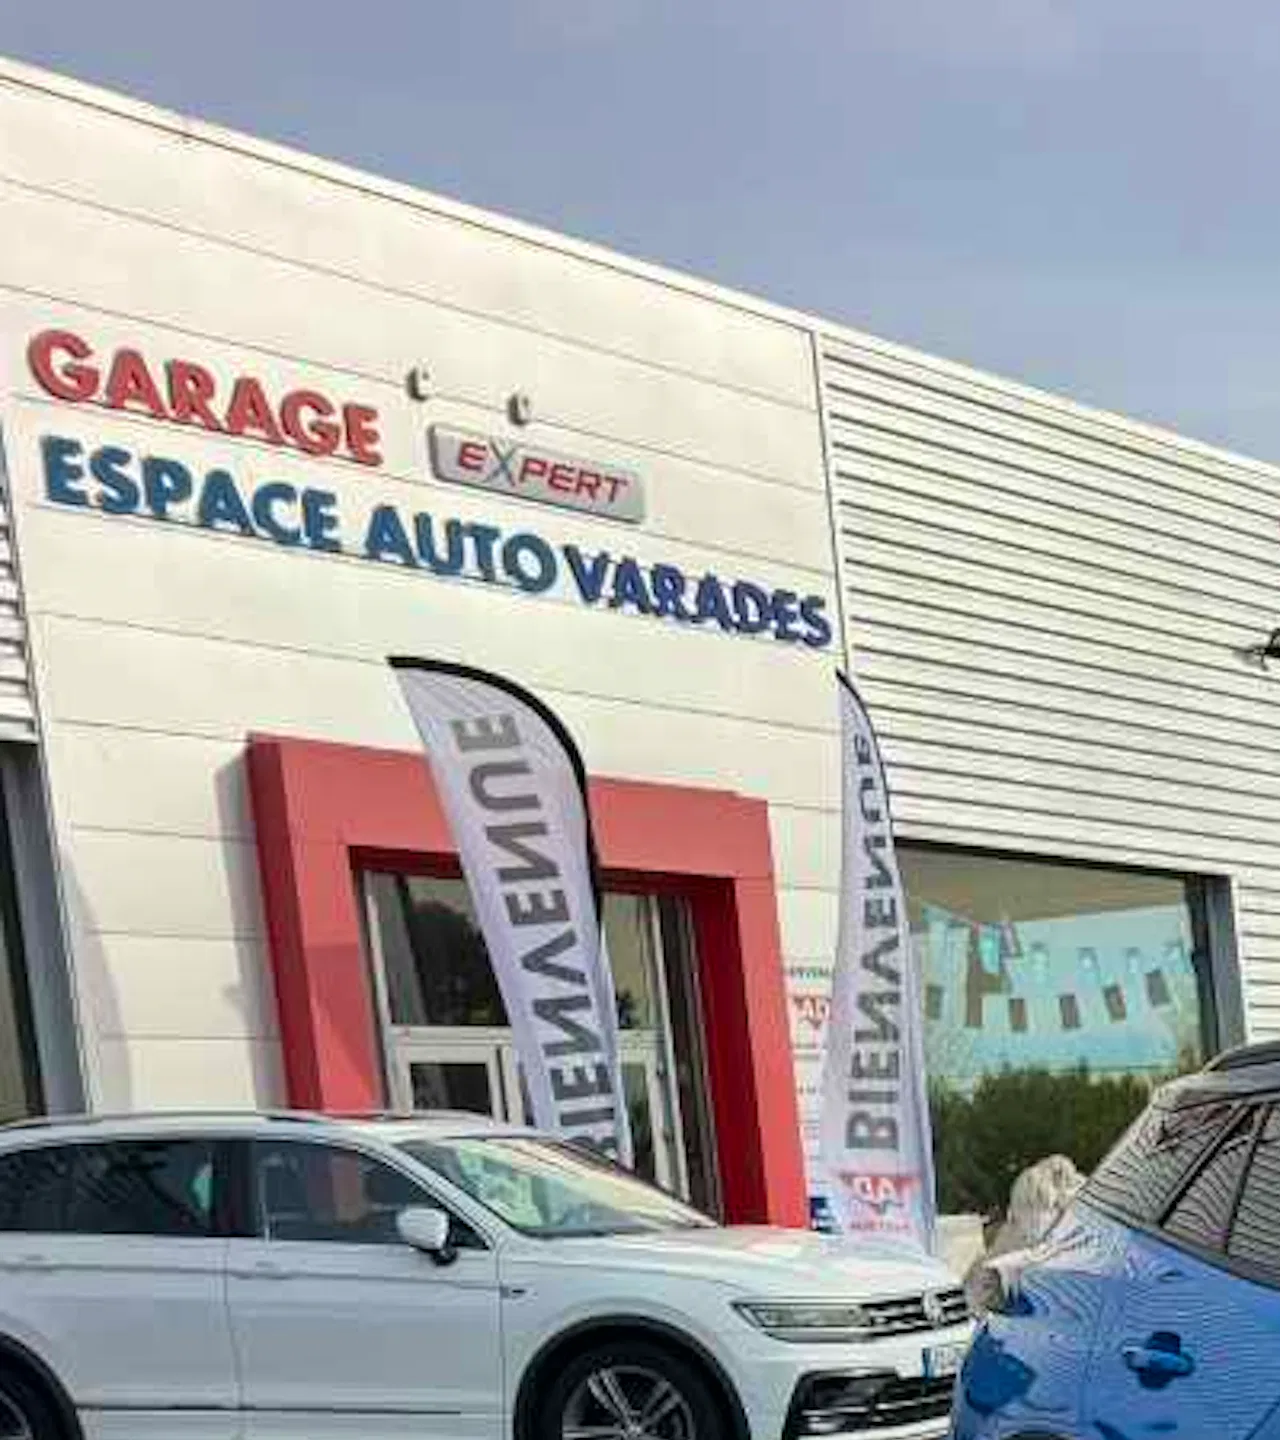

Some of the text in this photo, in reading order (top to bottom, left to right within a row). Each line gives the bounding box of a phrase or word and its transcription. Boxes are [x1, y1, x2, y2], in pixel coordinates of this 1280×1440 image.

[27, 329, 384, 468] GARAGE
[457, 436, 629, 503] EXPERT
[41, 436, 834, 650] ESPACE AUTO VARADES
